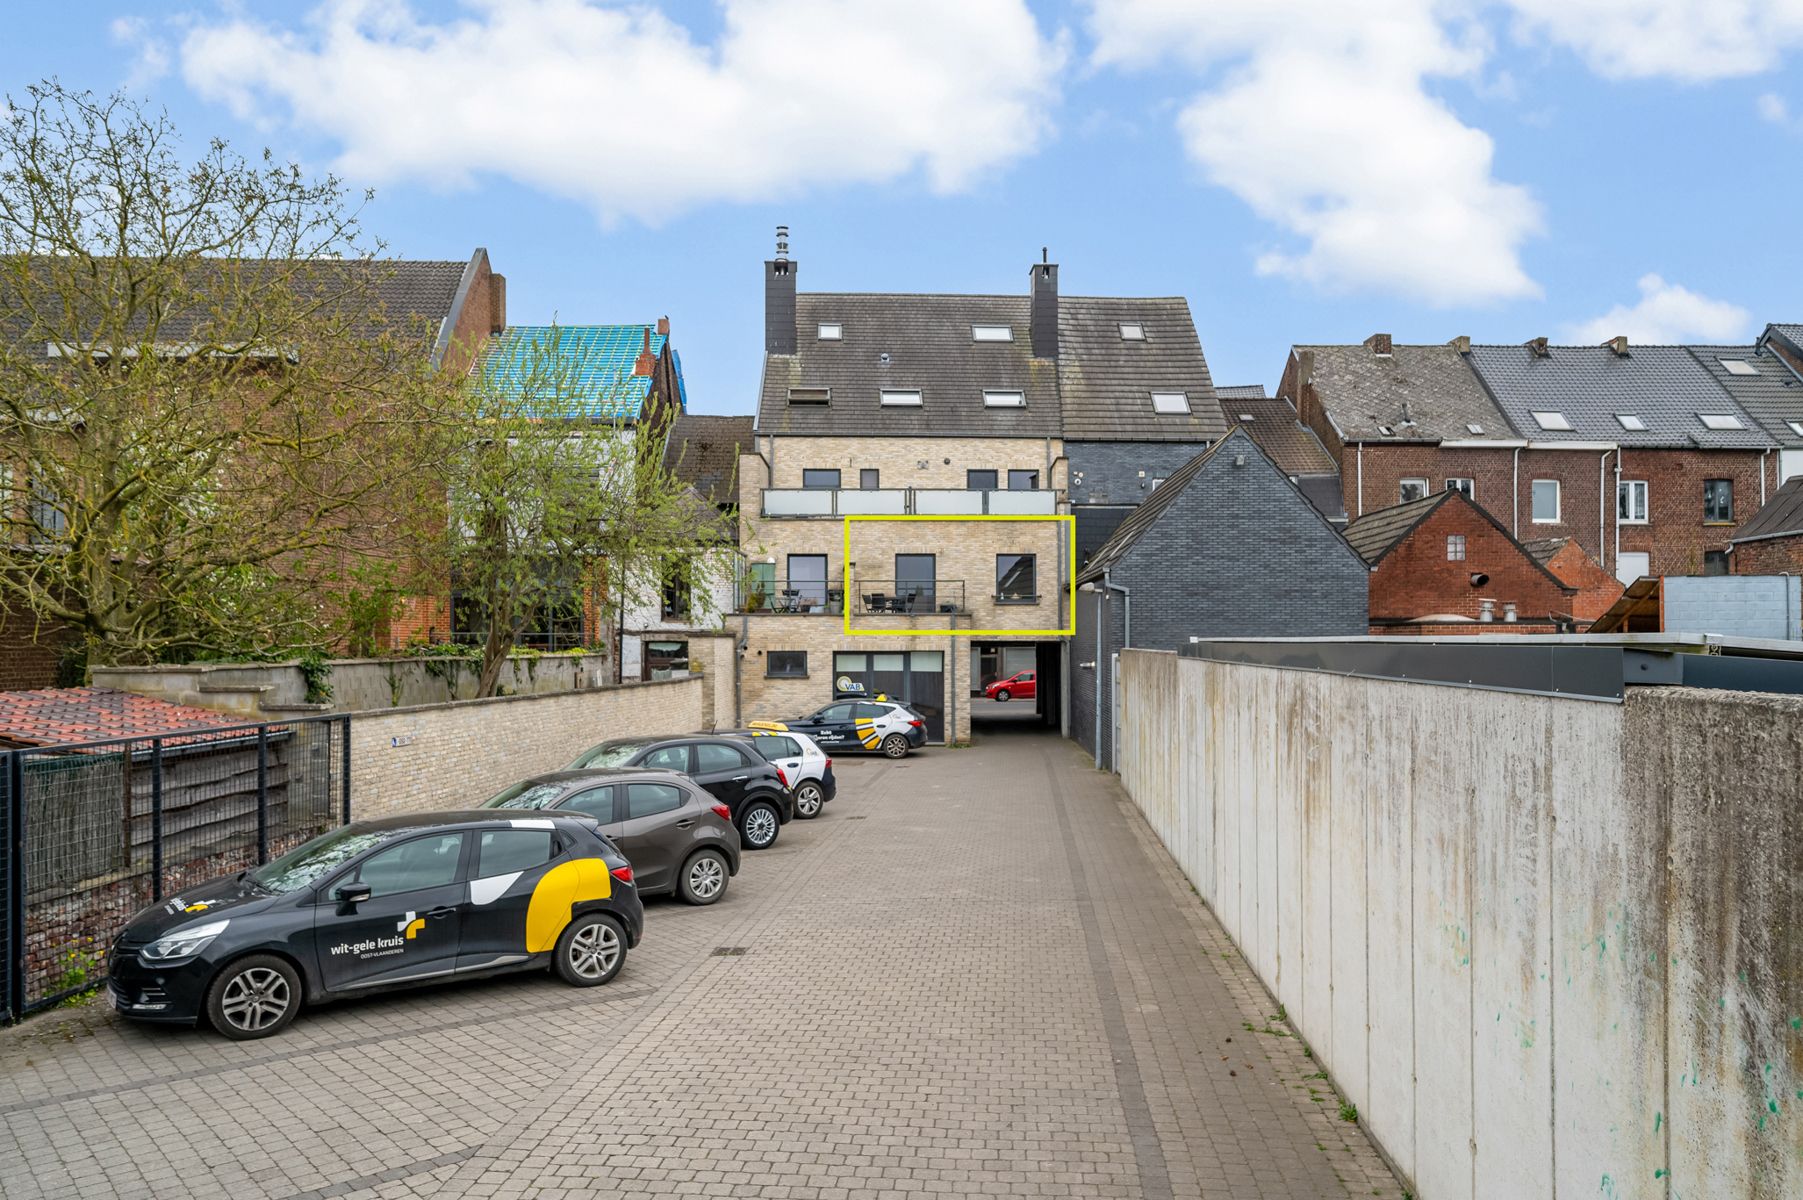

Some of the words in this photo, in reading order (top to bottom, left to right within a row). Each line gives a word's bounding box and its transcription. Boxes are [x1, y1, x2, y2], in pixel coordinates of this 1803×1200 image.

[845, 682, 861, 691] VAB
[331, 939, 376, 955] wit-gele
[377, 935, 404, 949] kruis
[360, 948, 404, 959] OOST-VLAANDEREN
